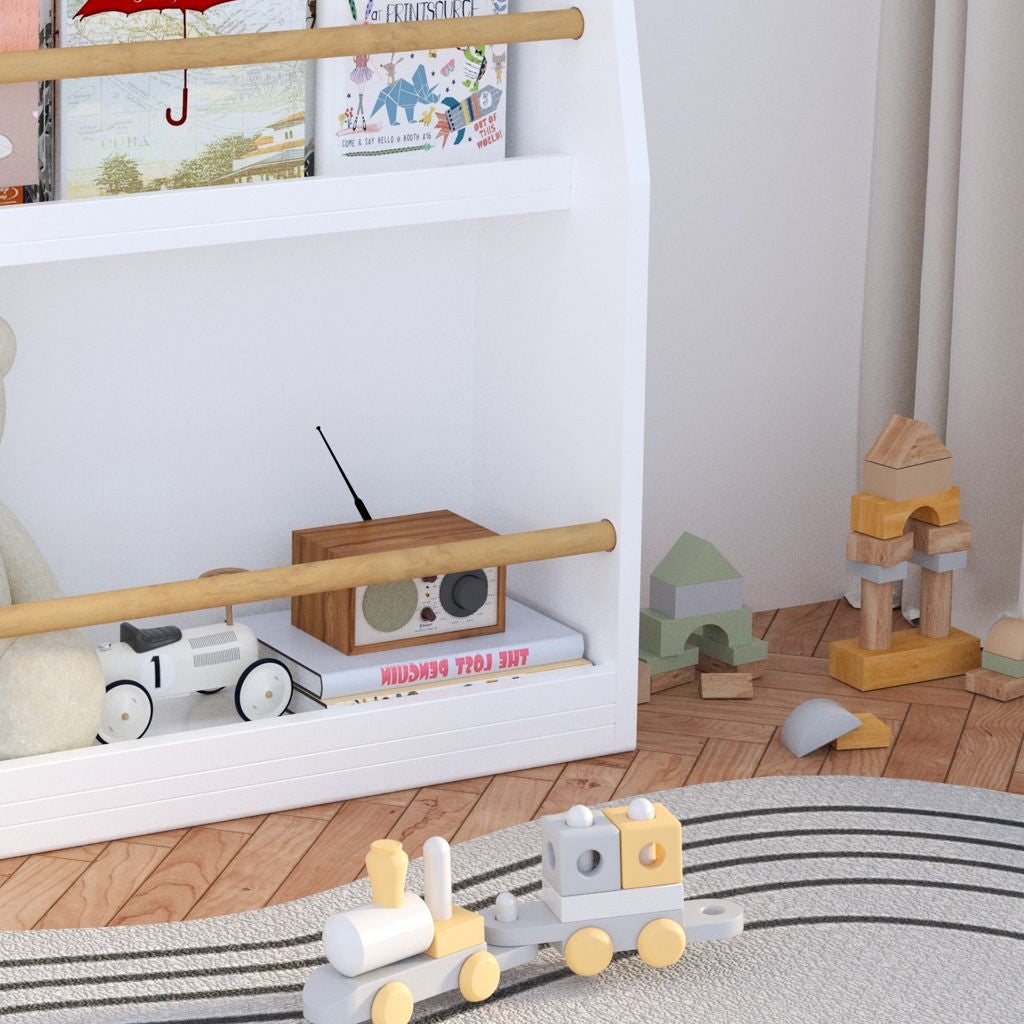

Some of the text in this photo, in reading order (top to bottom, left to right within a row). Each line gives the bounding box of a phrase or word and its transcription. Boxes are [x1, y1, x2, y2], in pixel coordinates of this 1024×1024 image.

[473, 112, 497, 132] OUT OF
[479, 124, 496, 138] THIS
[341, 138, 356, 148] COME
[364, 137, 375, 145] SAY
[377, 135, 394, 144] HELLO
[403, 132, 420, 142] BOOTH
[476, 130, 503, 150] WORLD!
[150, 655, 161, 689] 1
